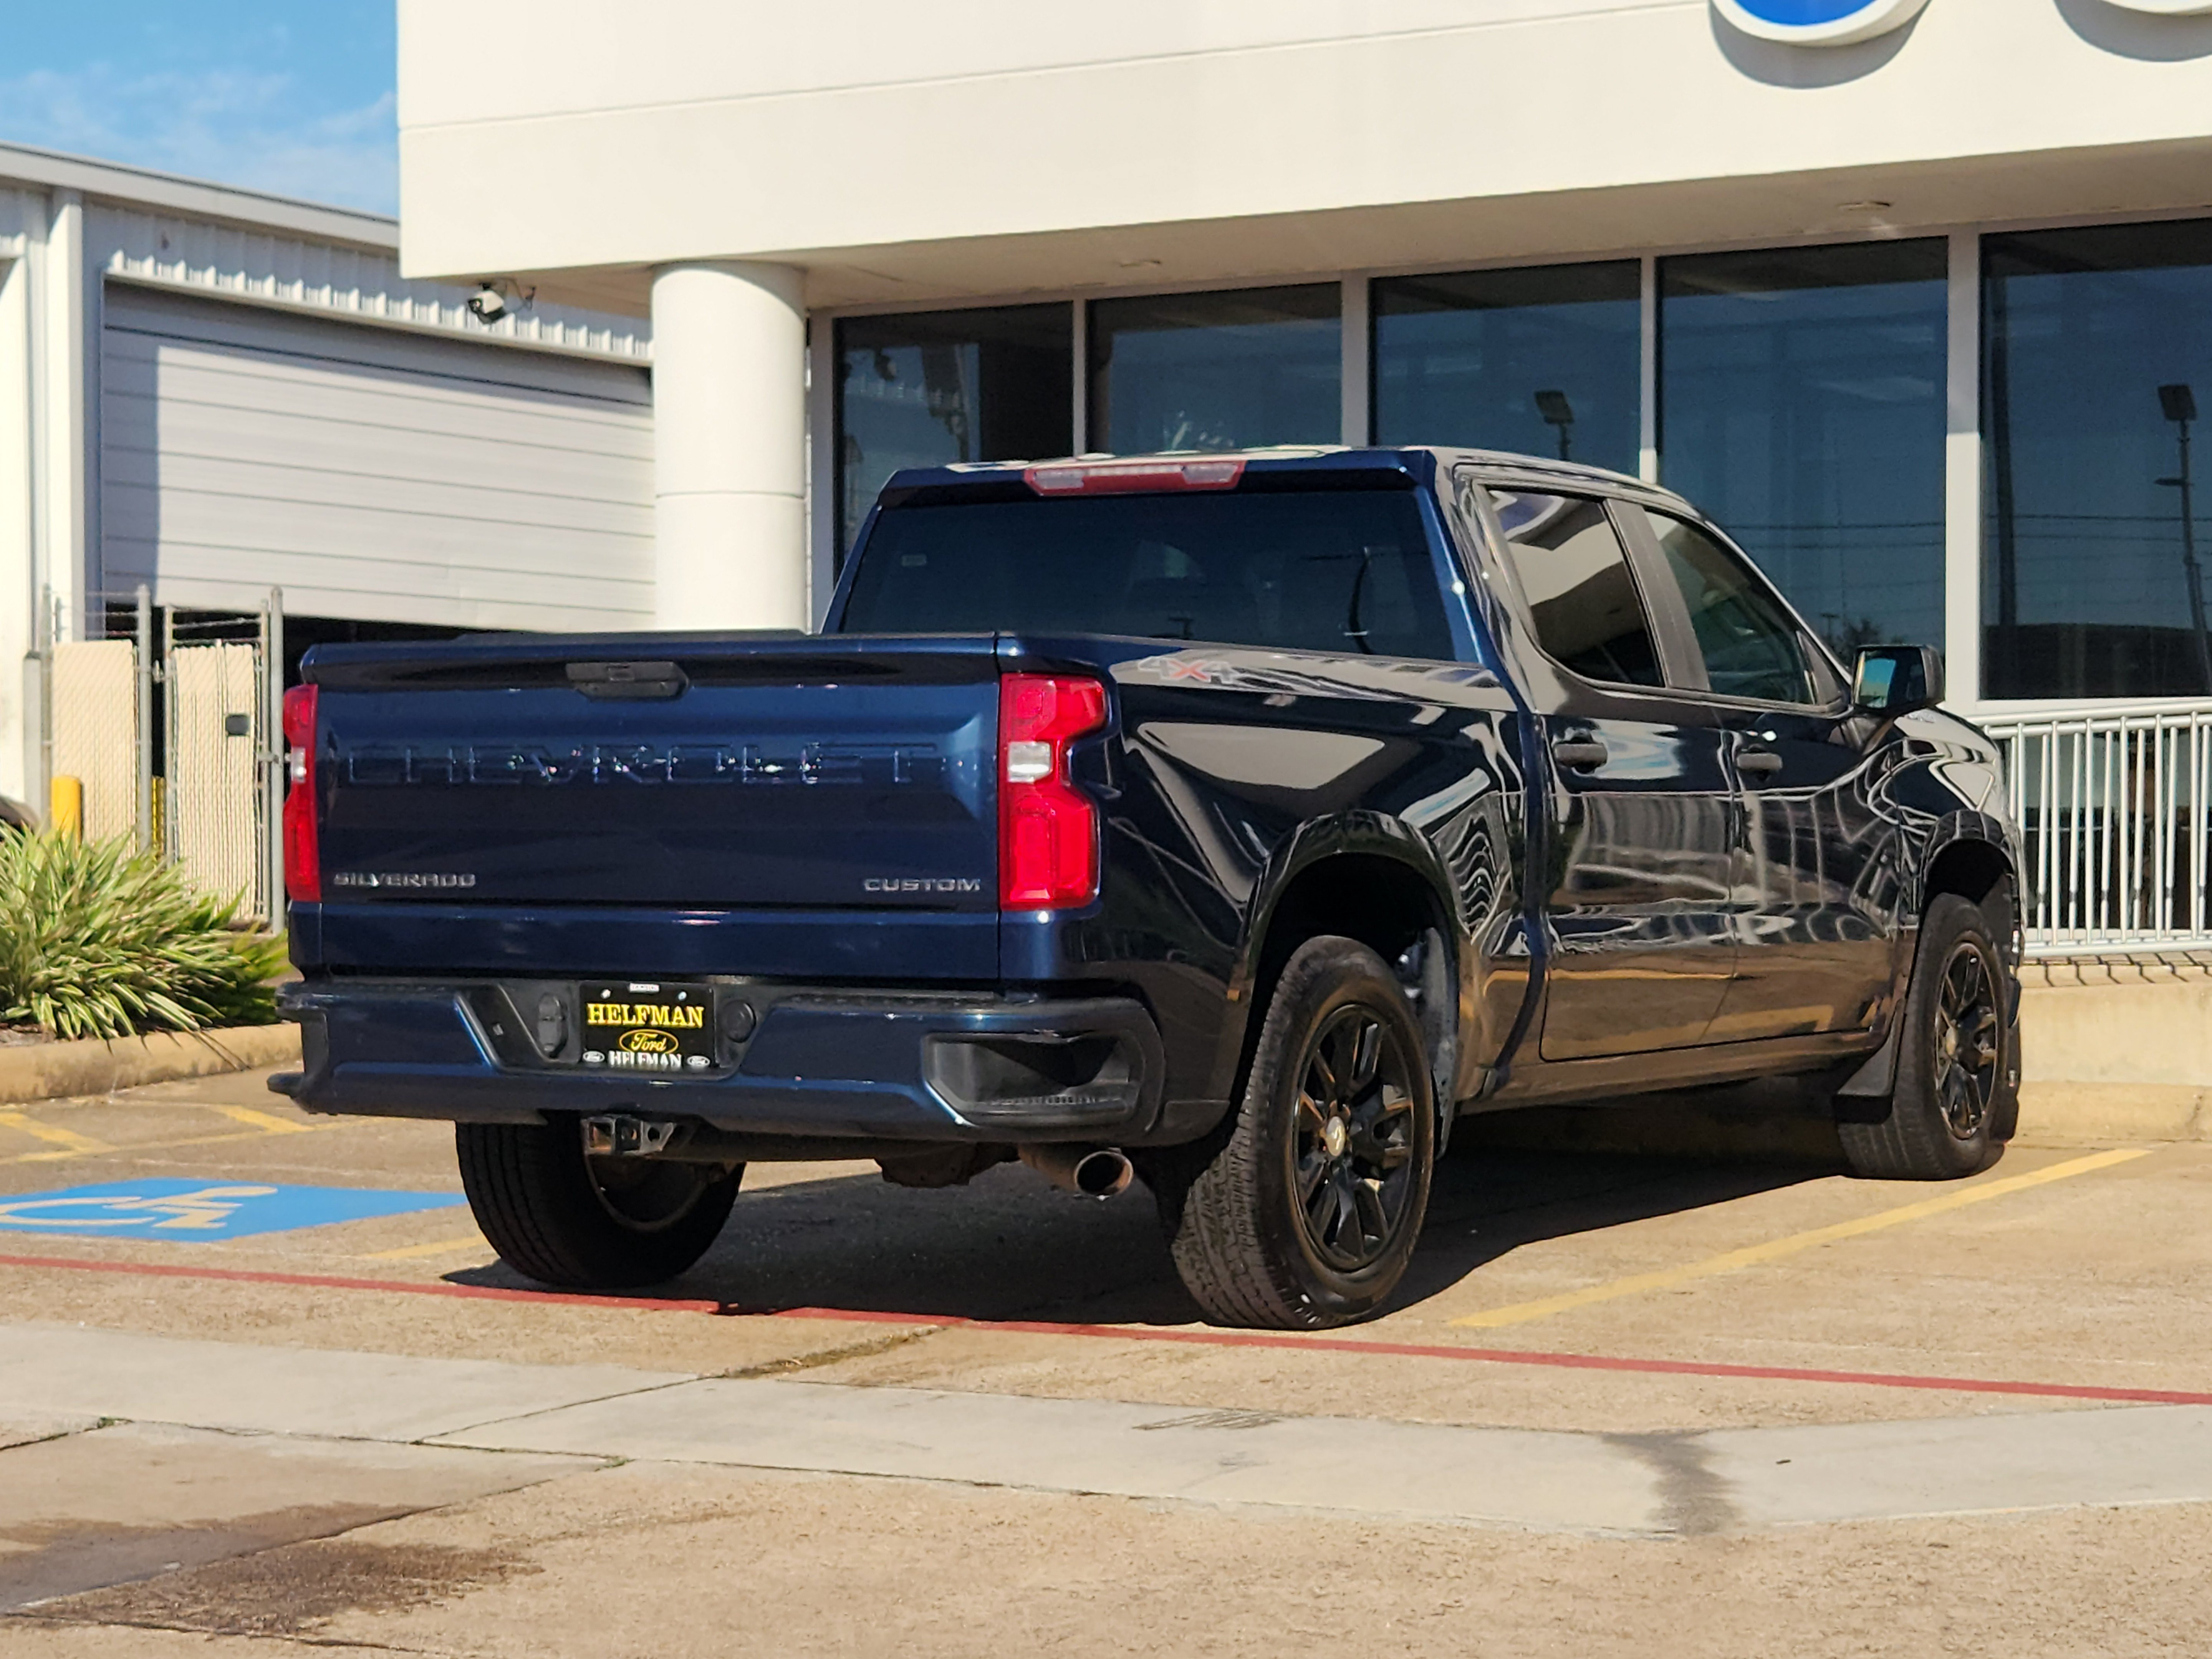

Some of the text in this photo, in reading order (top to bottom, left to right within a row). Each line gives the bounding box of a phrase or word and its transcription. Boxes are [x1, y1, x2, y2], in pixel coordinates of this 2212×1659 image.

[349, 743, 937, 783] CHEVROLET
[334, 873, 475, 887] SILVERADO
[864, 878, 980, 891] CUSTOM
[587, 1003, 704, 1028] HELFMAN
[631, 1032, 667, 1051] Ford
